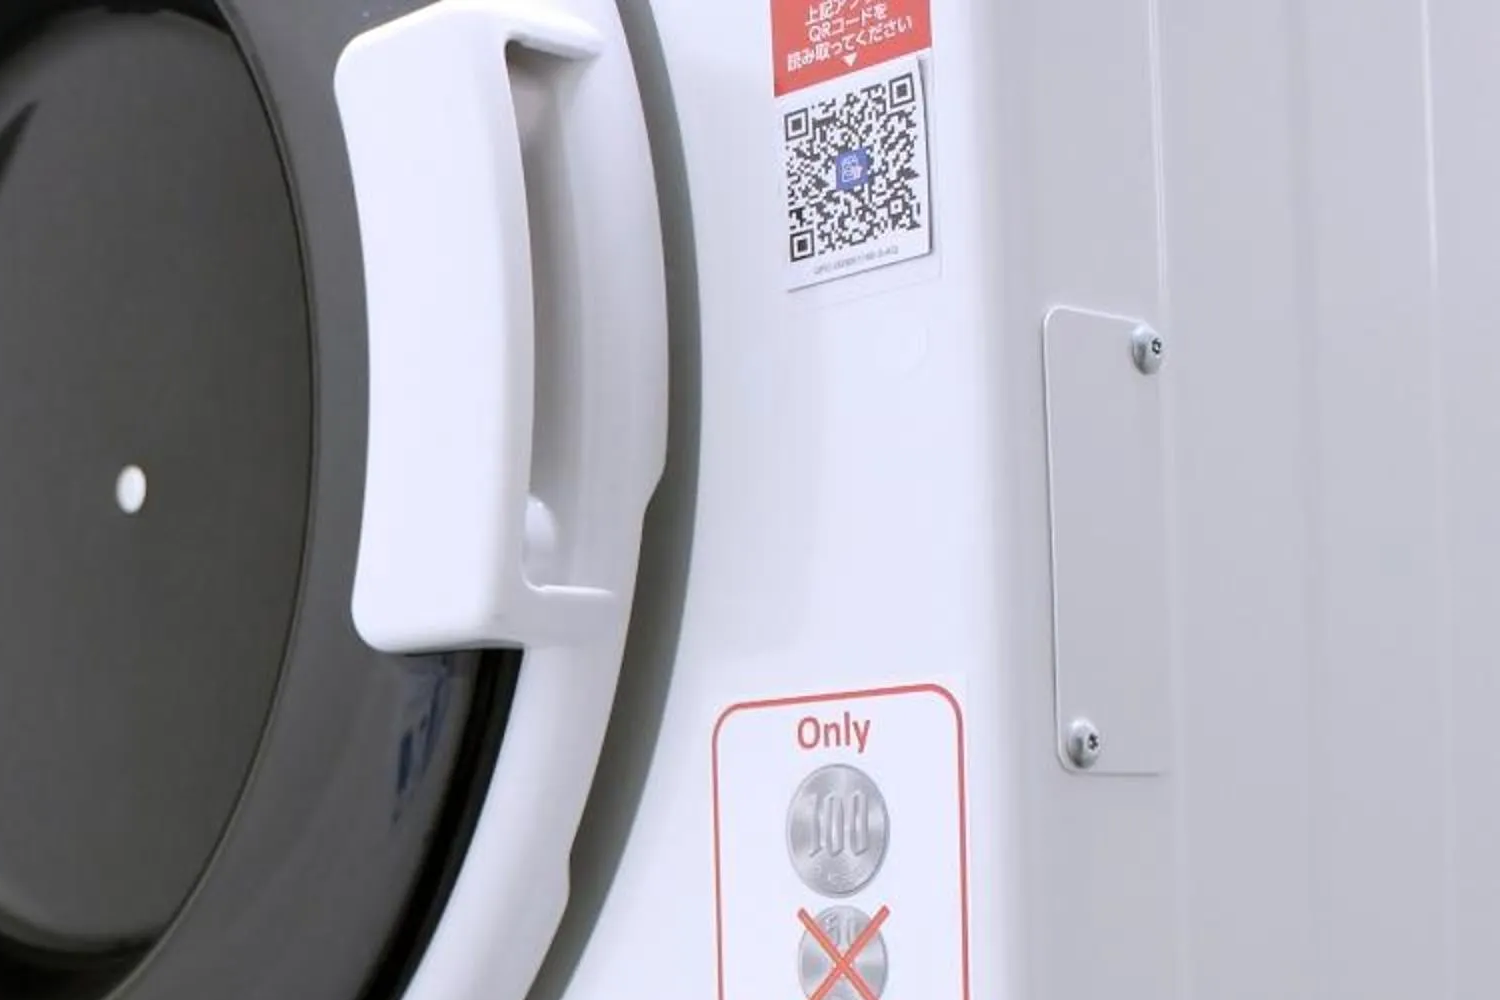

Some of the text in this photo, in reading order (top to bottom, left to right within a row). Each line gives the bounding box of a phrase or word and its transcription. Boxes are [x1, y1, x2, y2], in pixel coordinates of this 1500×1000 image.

[787, 15, 913, 72] 読み取ってください
[808, 3, 887, 42] QRコードを
[798, 711, 870, 753] Only
